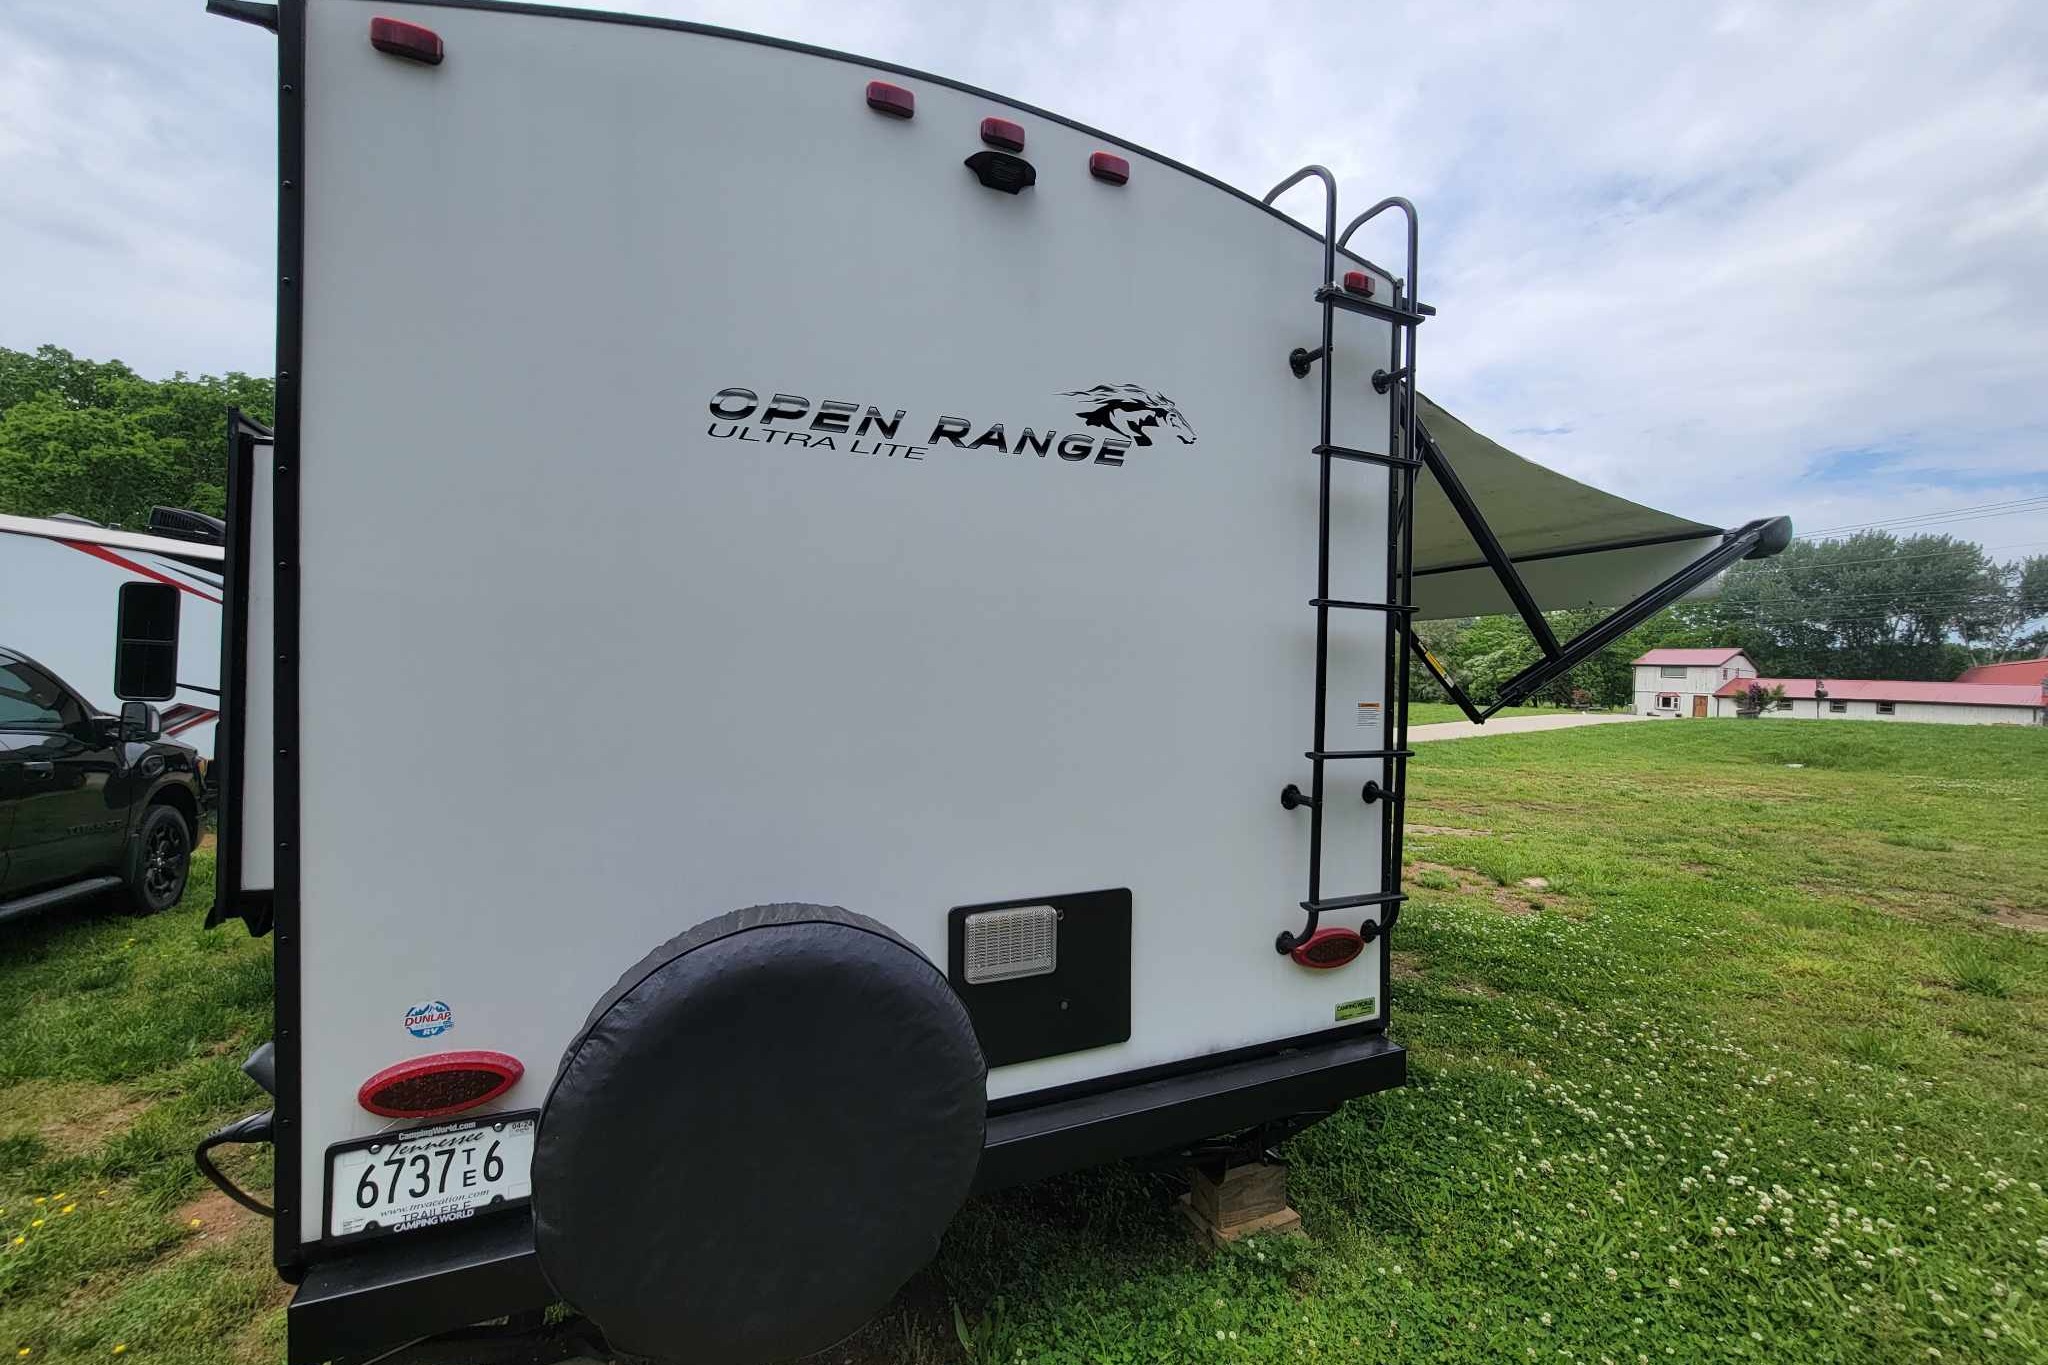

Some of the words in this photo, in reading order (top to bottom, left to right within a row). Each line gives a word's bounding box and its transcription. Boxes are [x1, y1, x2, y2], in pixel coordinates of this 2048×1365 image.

[707, 422, 837, 451] ULTRA
[850, 439, 929, 460] LITE
[709, 387, 907, 440] OPEN
[928, 415, 1132, 467] RANGE
[405, 1012, 451, 1026] DUNLAP
[385, 1131, 485, 1162] Tennessee
[398, 1121, 477, 1141] CampingWorld.com
[356, 1147, 456, 1209] 6737
[393, 1216, 439, 1233] CAMPING
[439, 1208, 475, 1224] WORLD
